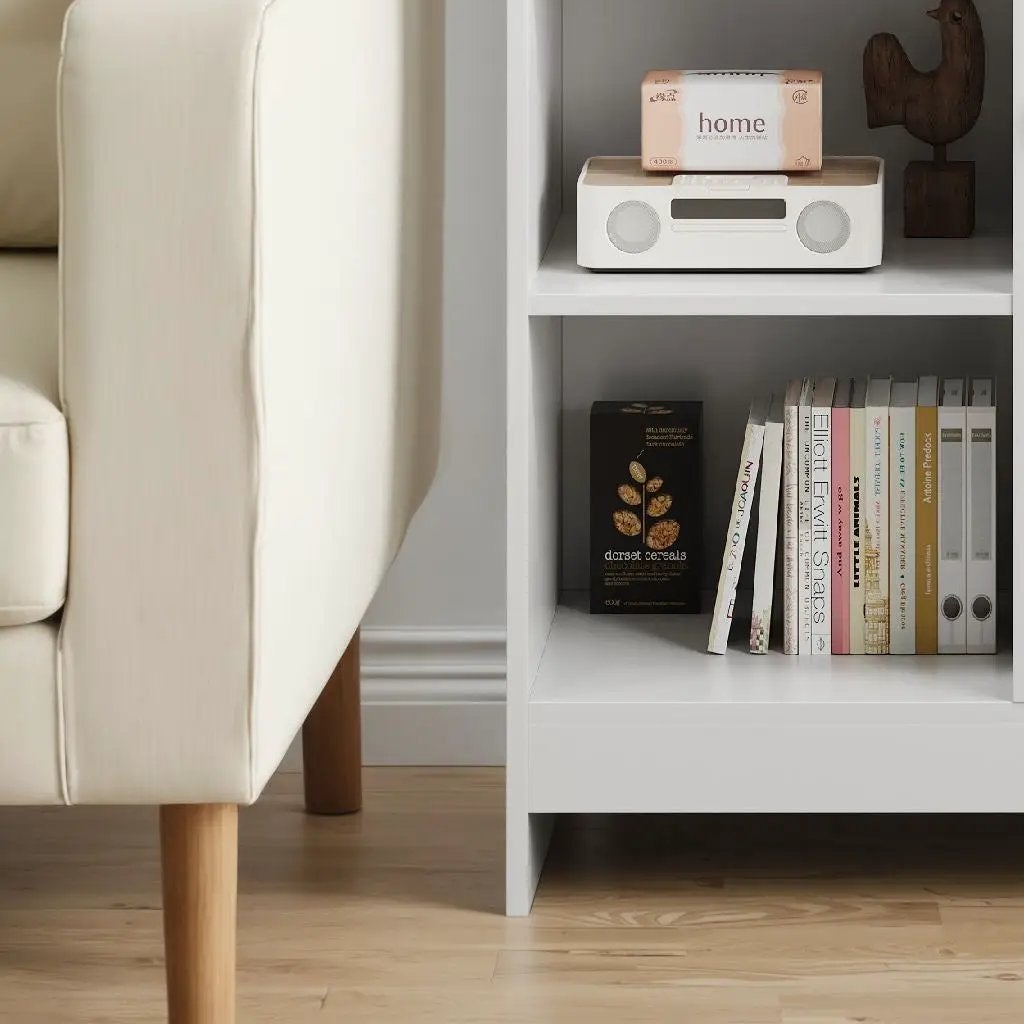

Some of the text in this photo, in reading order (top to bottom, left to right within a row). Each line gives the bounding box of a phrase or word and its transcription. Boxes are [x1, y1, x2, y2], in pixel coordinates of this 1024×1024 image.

[699, 112, 766, 133] home
[922, 469, 932, 504] Antoine
[811, 414, 829, 624] Elliott Erwitt Snaps
[604, 549, 687, 562] dorset cereals
